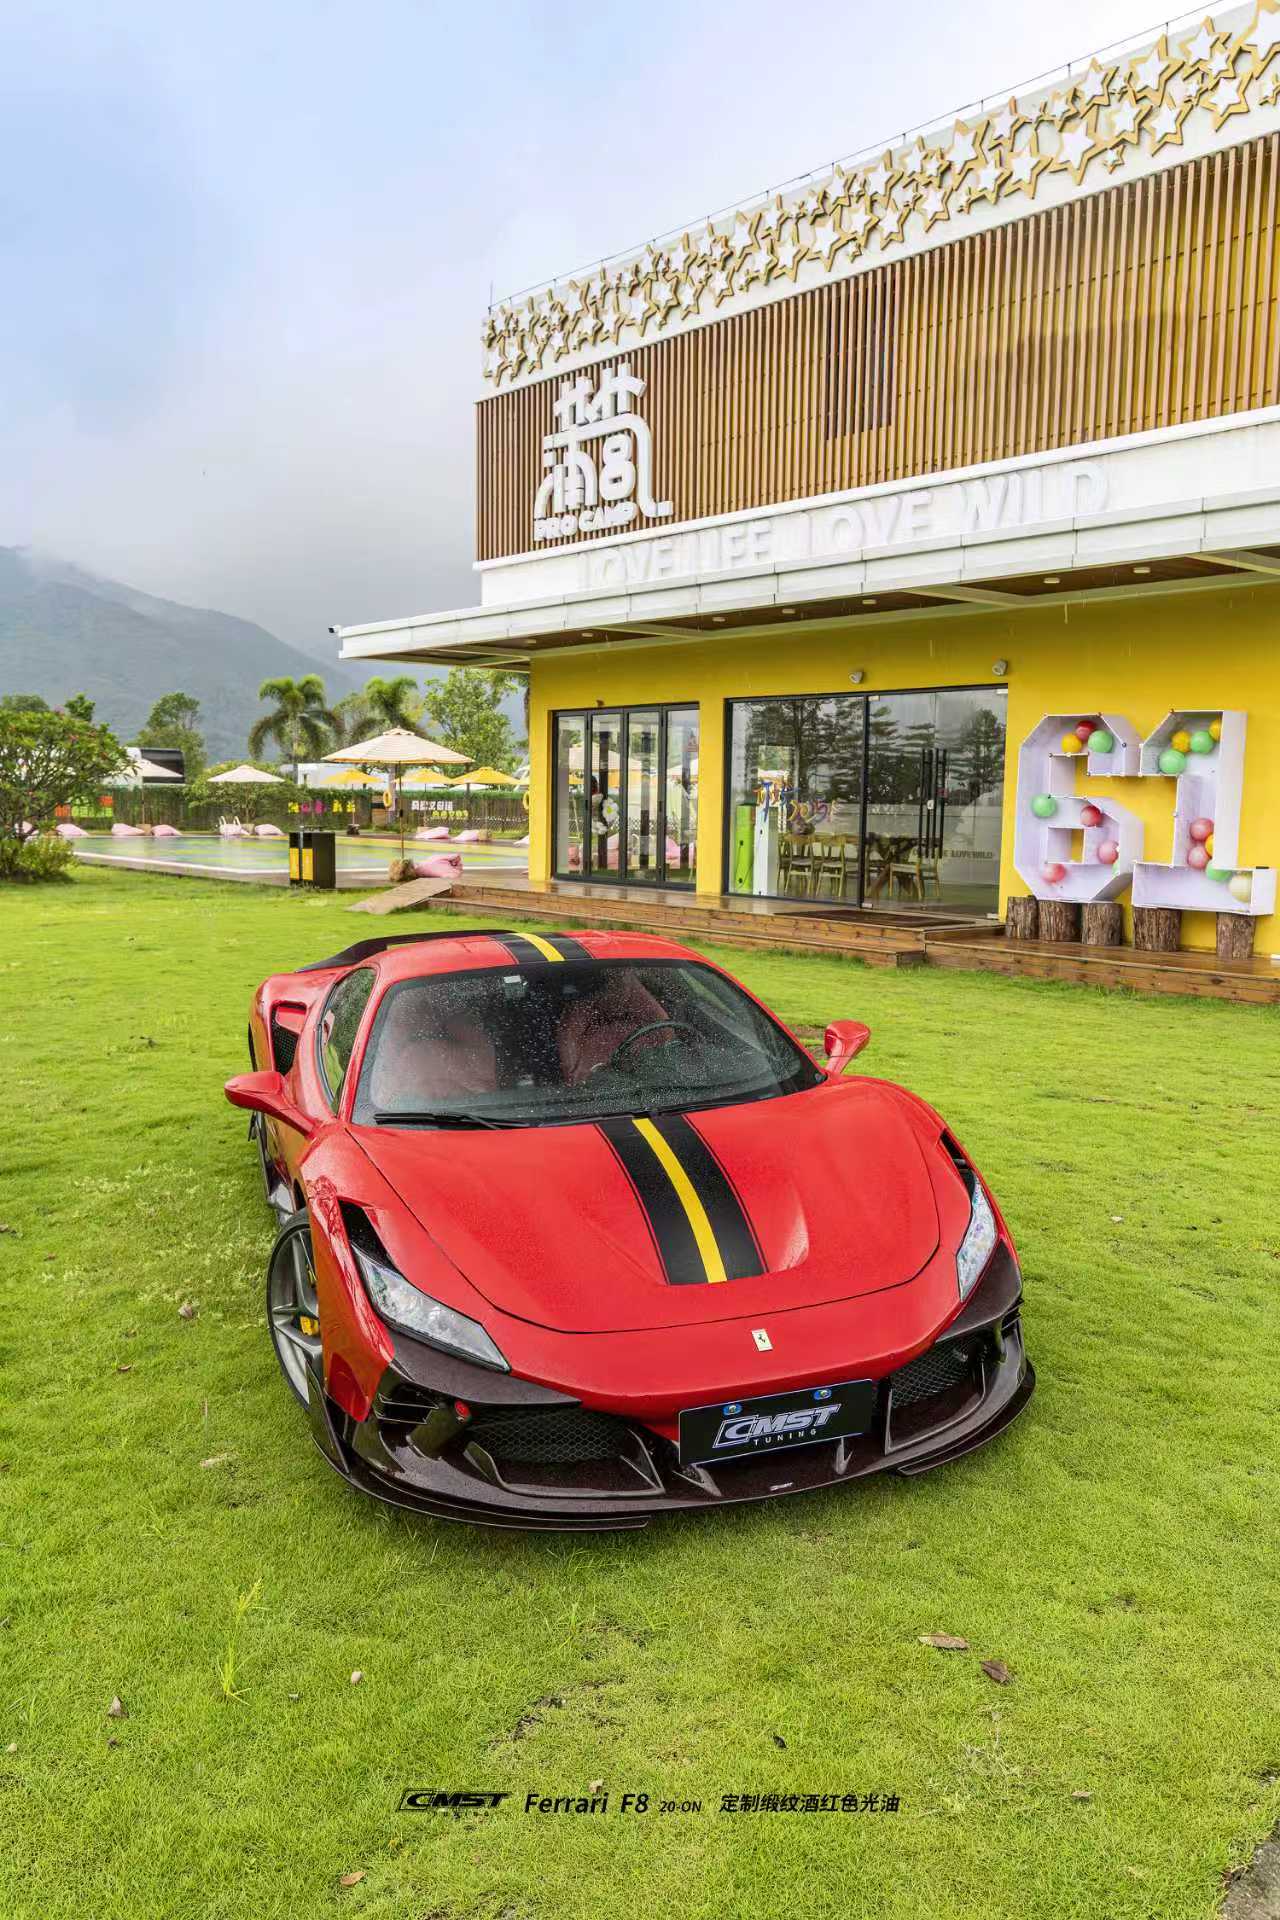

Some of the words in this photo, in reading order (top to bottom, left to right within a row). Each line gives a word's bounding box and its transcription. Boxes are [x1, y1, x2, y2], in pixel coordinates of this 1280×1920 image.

[580, 541, 672, 586] LOVE
[681, 522, 772, 575] LIFE
[806, 492, 932, 558] LOVE
[960, 462, 1109, 533] WILD
[753, 1429, 817, 1446] TUNING
